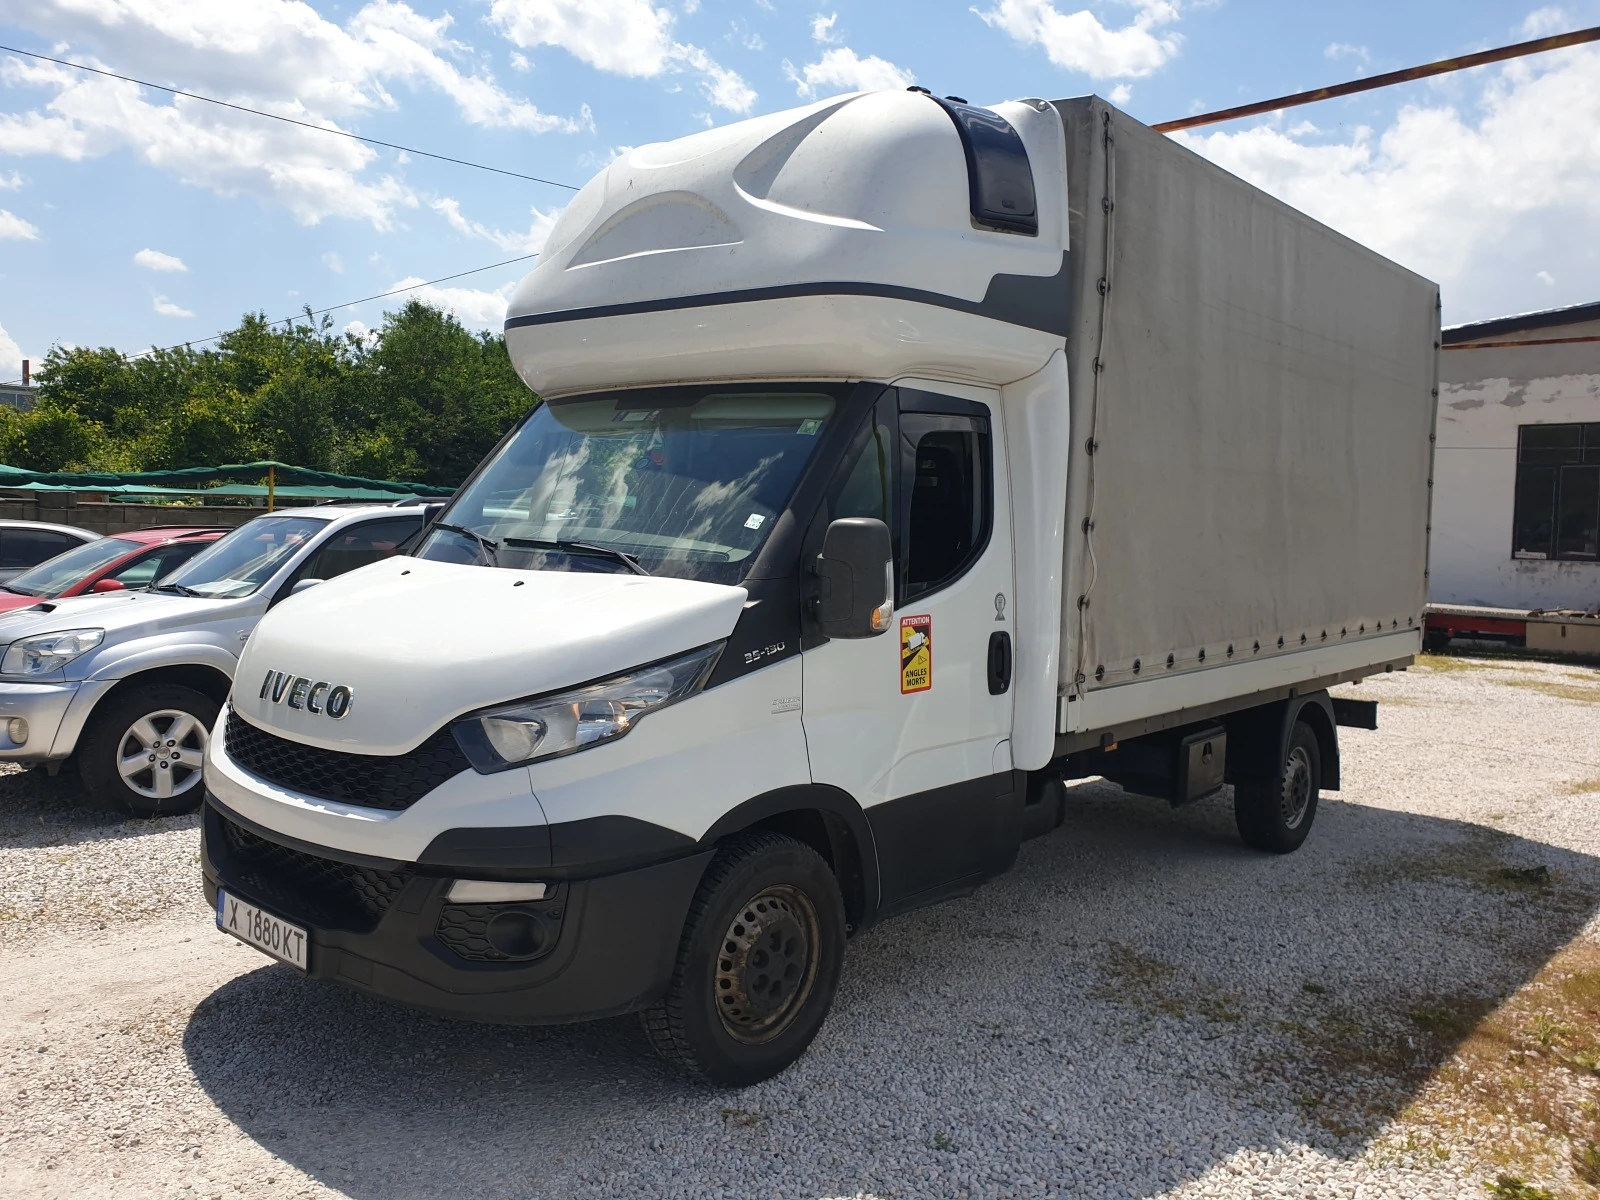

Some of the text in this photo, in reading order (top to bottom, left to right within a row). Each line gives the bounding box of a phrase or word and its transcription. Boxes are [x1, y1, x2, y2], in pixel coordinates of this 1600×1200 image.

[902, 616, 930, 626] ATTENTION
[905, 668, 927, 678] ANGLES
[906, 676, 926, 687] MORTS
[259, 668, 354, 720] IVECO
[229, 899, 239, 931] X
